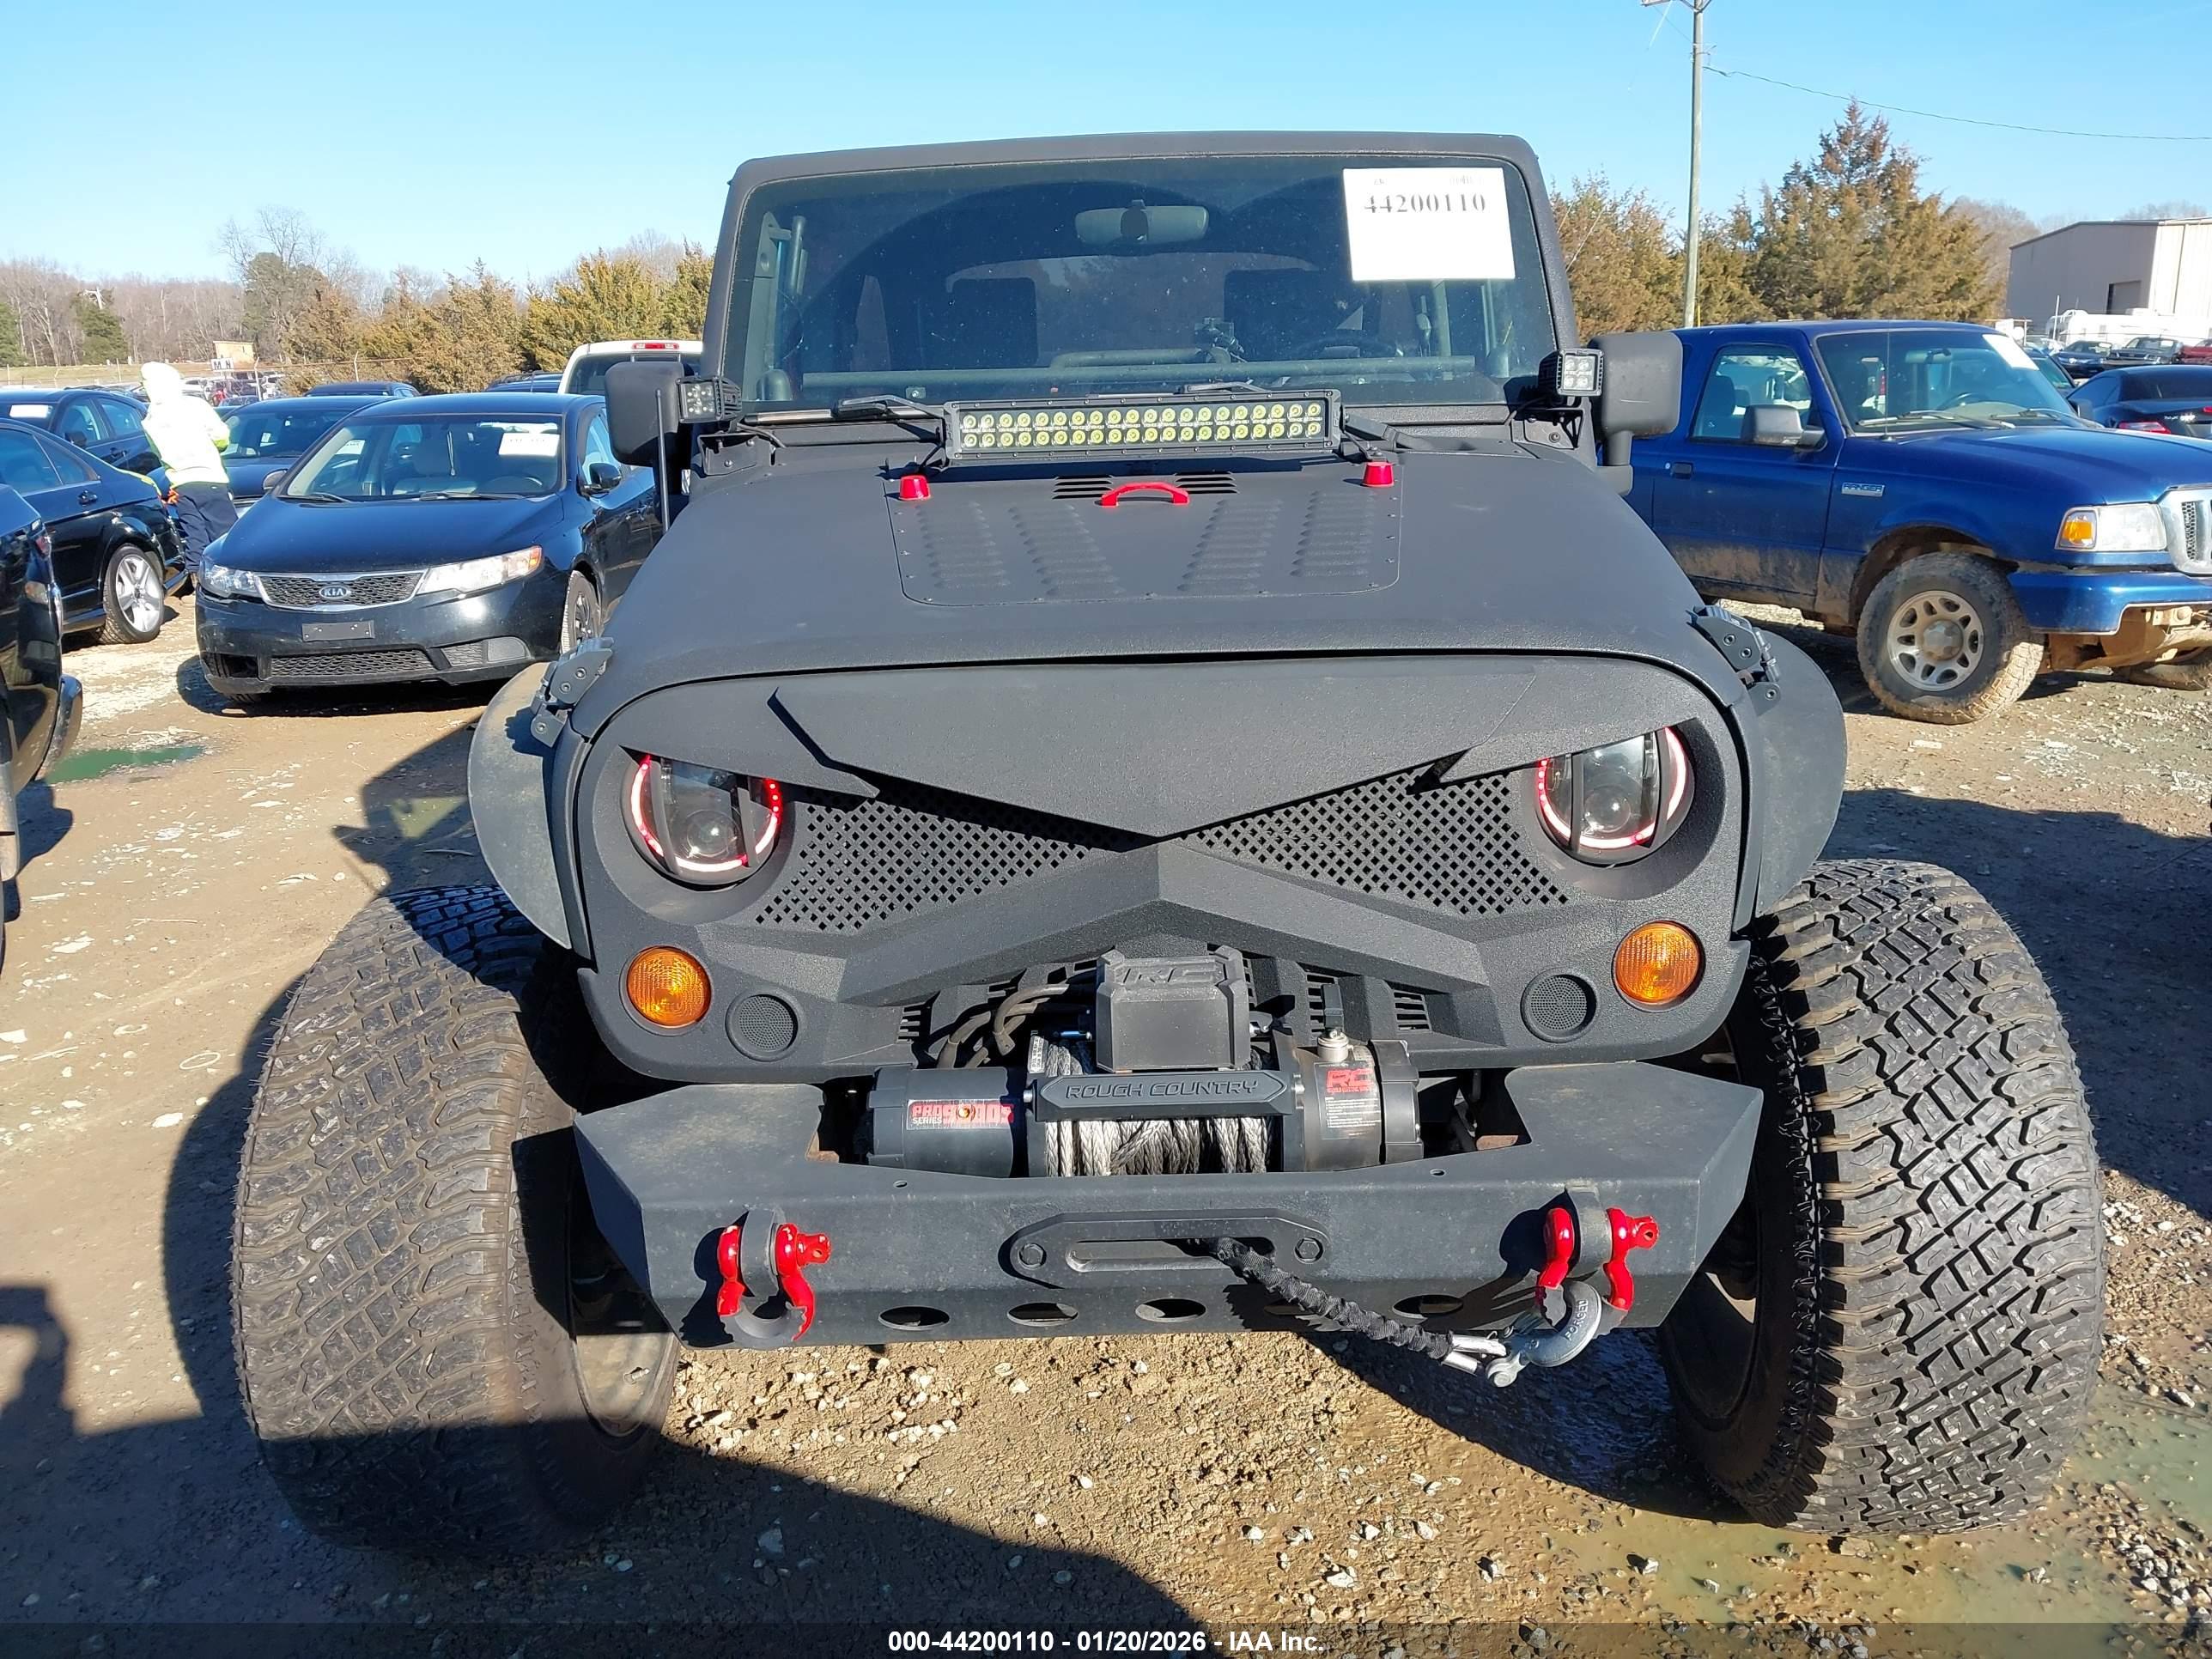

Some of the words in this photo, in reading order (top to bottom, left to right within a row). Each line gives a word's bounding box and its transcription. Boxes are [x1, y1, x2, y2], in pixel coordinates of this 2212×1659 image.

[1364, 193, 1486, 213] 44200110
[1844, 483, 1882, 491] RANGER
[1327, 1067, 1374, 1088] RC
[1066, 1083, 1142, 1099] ROUGH
[1149, 1079, 1258, 1097] COUNTRY
[912, 1104, 943, 1117] PRO
[912, 1116, 942, 1125] SERIES
[1565, 1299, 1589, 1341] FORGED
